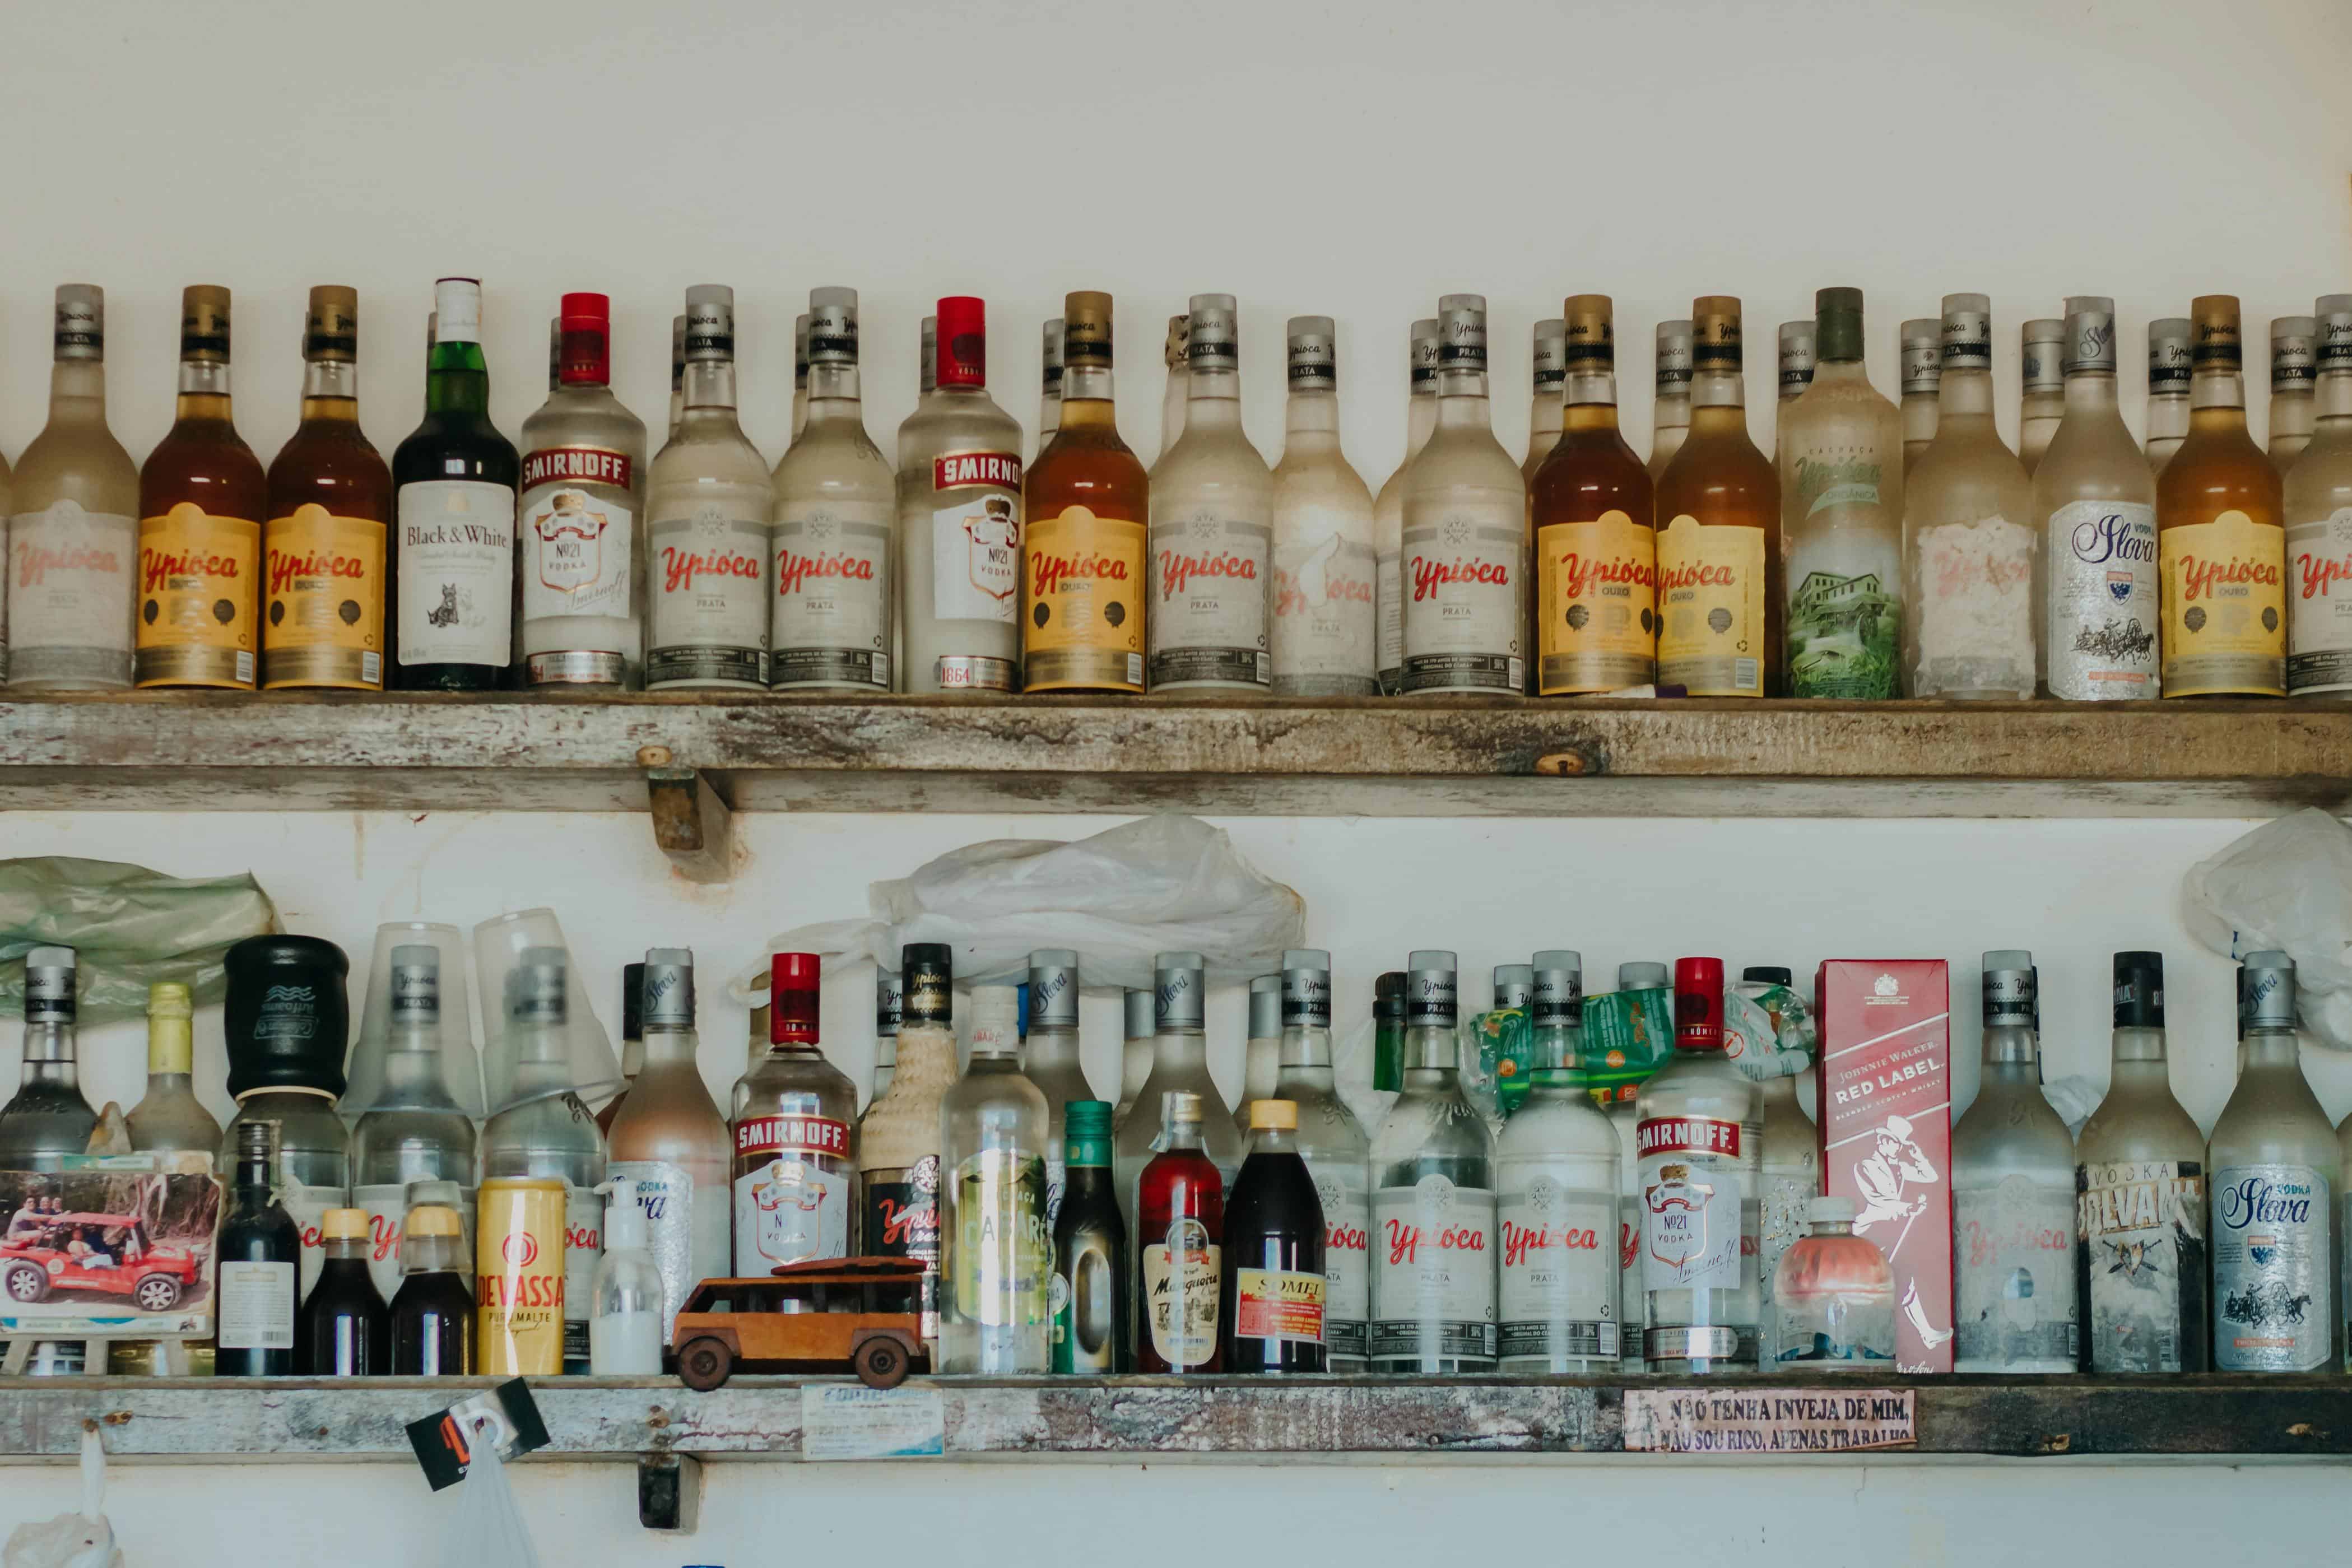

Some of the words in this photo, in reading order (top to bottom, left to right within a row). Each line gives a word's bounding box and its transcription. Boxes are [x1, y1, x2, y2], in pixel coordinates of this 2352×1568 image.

[2331, 347, 2352, 356] PRAT
[524, 453, 623, 481] SMIRNOFF
[944, 456, 1020, 484] SMIRNO
[407, 527, 445, 547] Black
[450, 528, 463, 543] &
[464, 524, 508, 548] White
[2072, 514, 2155, 564] Slova
[143, 547, 239, 594] Ypióca
[268, 548, 364, 594] Ypióca
[550, 561, 587, 570] VODKA
[662, 546, 760, 593] Ypióca
[777, 549, 873, 595] Ypióca
[981, 566, 1011, 576] VODKA
[1032, 551, 1128, 597] Ypióca
[1159, 550, 1257, 596] Ypióca
[1411, 555, 1509, 602] Ypióca
[1561, 552, 1653, 598] Ypióca
[2179, 555, 2279, 601] Ypióca
[2297, 553, 2352, 599] Ypi
[696, 599, 726, 608] PRATA
[806, 601, 834, 610] PRATA
[1191, 601, 1219, 610] PRATA
[1601, 586, 1630, 597] OURO
[1670, 590, 1694, 602] OURO
[2219, 587, 2248, 597] OURO
[1443, 606, 1471, 616] PRATA
[2335, 604, 2352, 613] PRA
[942, 667, 970, 683] 1864
[1839, 1057, 1888, 1084] JOHNNIE
[1888, 1040, 1938, 1063] WALKER
[1835, 1080, 1874, 1105] RED
[1877, 1057, 1941, 1089] LABEL
[1875, 1091, 1907, 1106] SCOTCH
[740, 1120, 842, 1149] SMIRNOFF
[1637, 1123, 1731, 1152] SMIRNOFF
[2277, 1183, 2311, 1195] VODKA
[2221, 1178, 2311, 1230] Slova
[564, 1221, 599, 1251] óca
[1324, 1221, 1367, 1251] ióca
[1385, 1218, 1485, 1265] Ypióca
[1502, 1220, 1598, 1268] Ypióca
[1658, 1233, 1693, 1243] VODKA
[478, 1275, 564, 1308] DEVASSA
[1326, 1273, 1341, 1282] ATA
[1531, 1274, 1559, 1283] PRATA
[517, 1312, 551, 1323] MALTE
[1670, 1393, 1707, 1421] NÃO
[1710, 1398, 1772, 1421] TENHA
[1775, 1398, 1839, 1421] INVEJA
[1844, 1398, 1868, 1421] DE
[1870, 1398, 1910, 1425] MIM,
[1695, 1429, 1724, 1450] SOU
[1727, 1429, 1767, 1453] RICO,
[1770, 1430, 1829, 1450] APENAS
